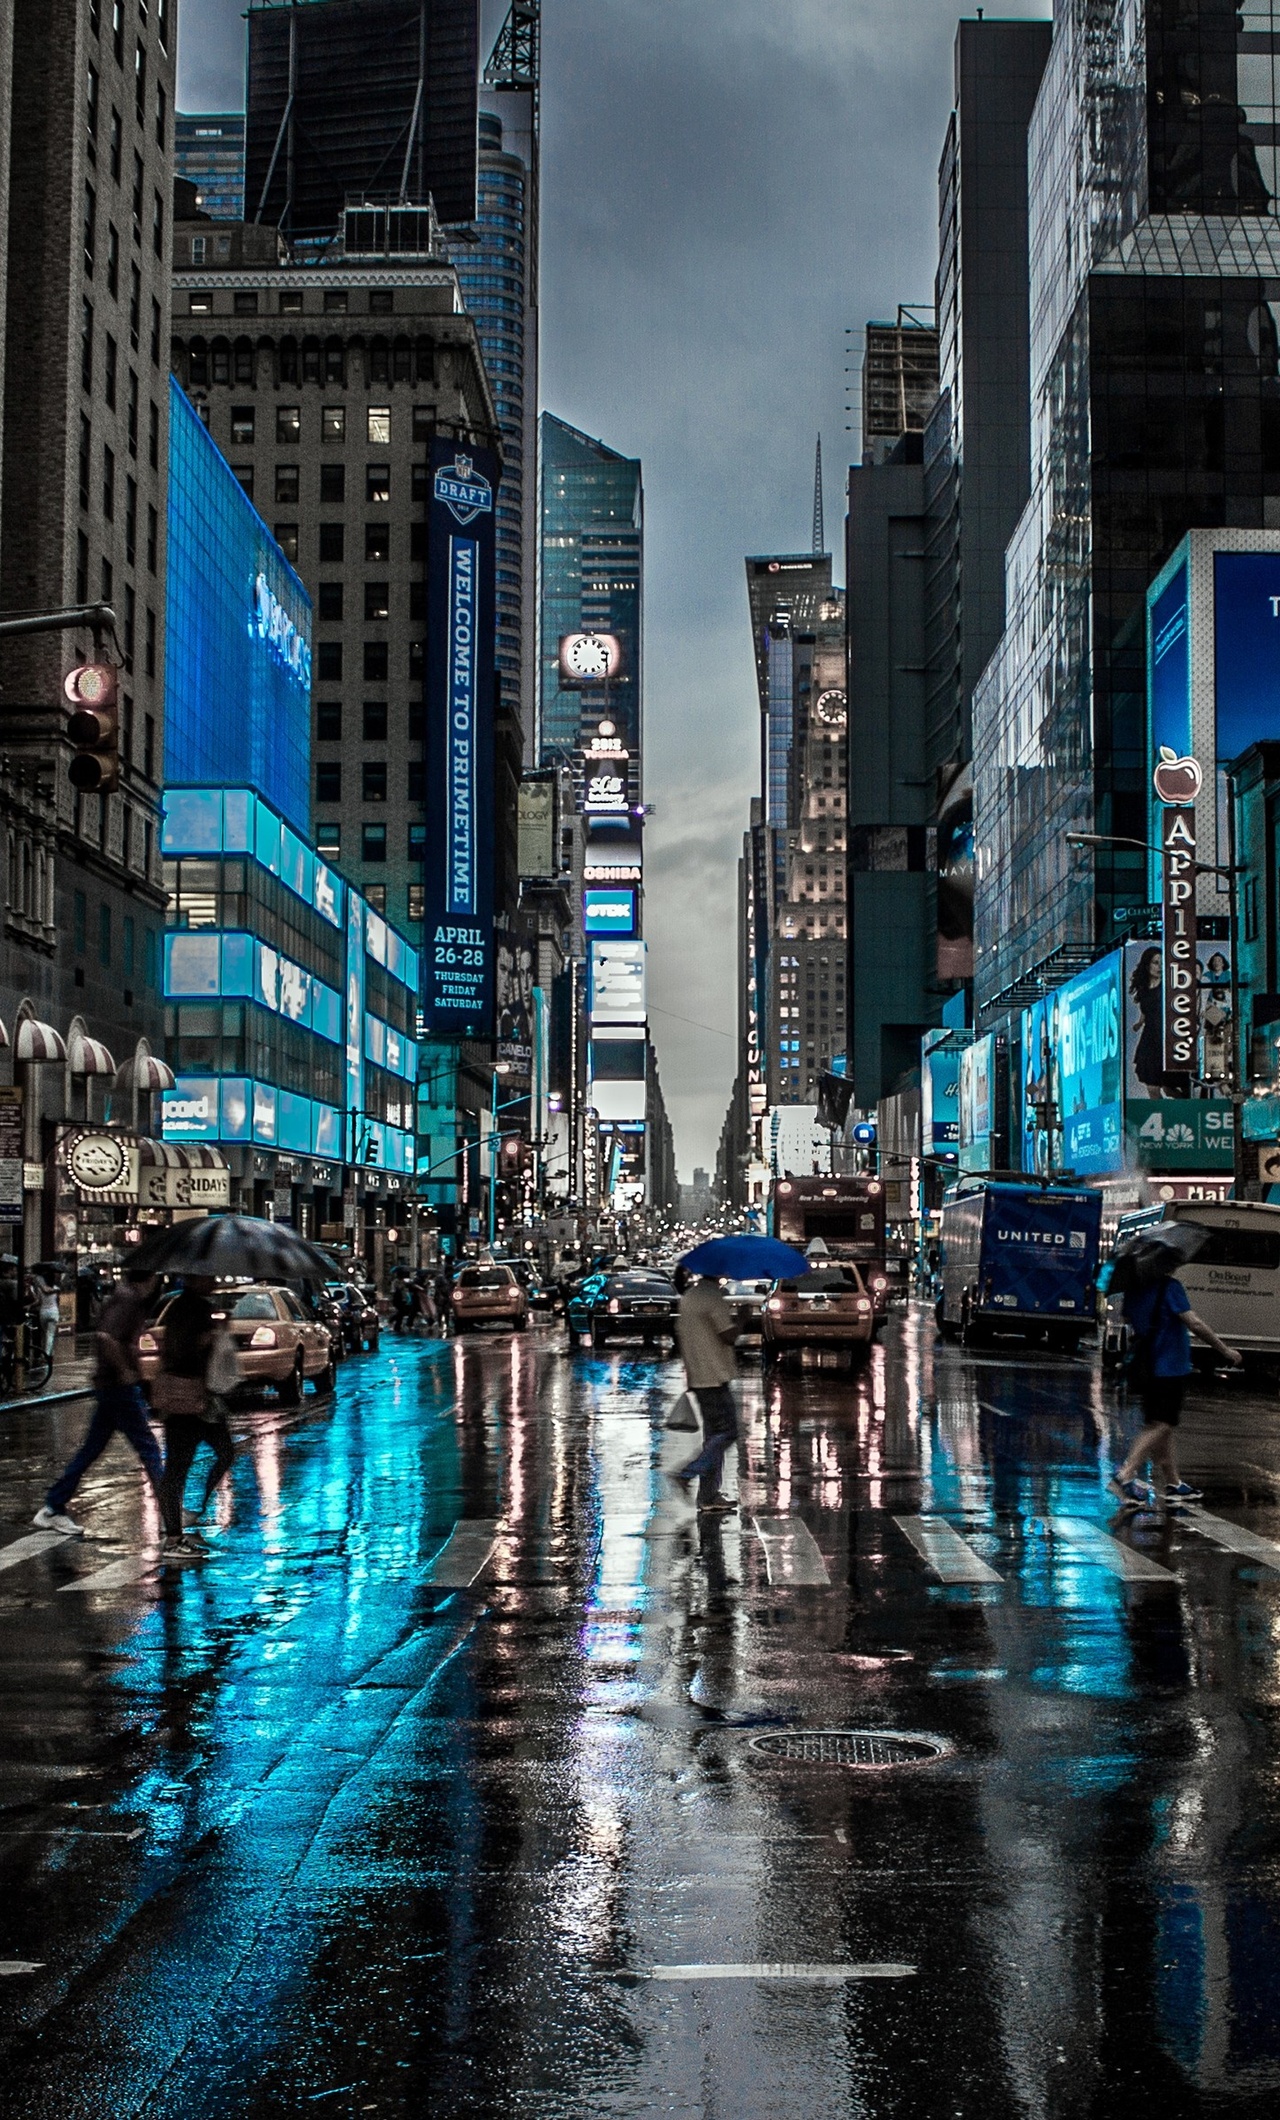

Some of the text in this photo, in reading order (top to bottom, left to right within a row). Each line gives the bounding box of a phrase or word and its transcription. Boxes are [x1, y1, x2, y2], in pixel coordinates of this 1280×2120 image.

[439, 481, 487, 503] DRAFT
[453, 548, 472, 904] WELCOME TO PRIMETIME
[584, 866, 641, 880] OSHIBA
[434, 926, 485, 946] APRIL
[1165, 815, 1195, 1061] Applebee's
[435, 947, 484, 966] 26-28
[434, 970, 485, 983] THURSDAY
[442, 984, 476, 996] FRIDAY
[434, 997, 484, 1009] SATURDAY
[1091, 987, 1118, 1065] KIDS
[1140, 1112, 1165, 1142] 4
[1140, 1142, 1163, 1150] NEW
[1164, 1142, 1194, 1150] YORK
[189, 1178, 227, 1192] RIDAY'S
[997, 1229, 1066, 1245] UNITED
